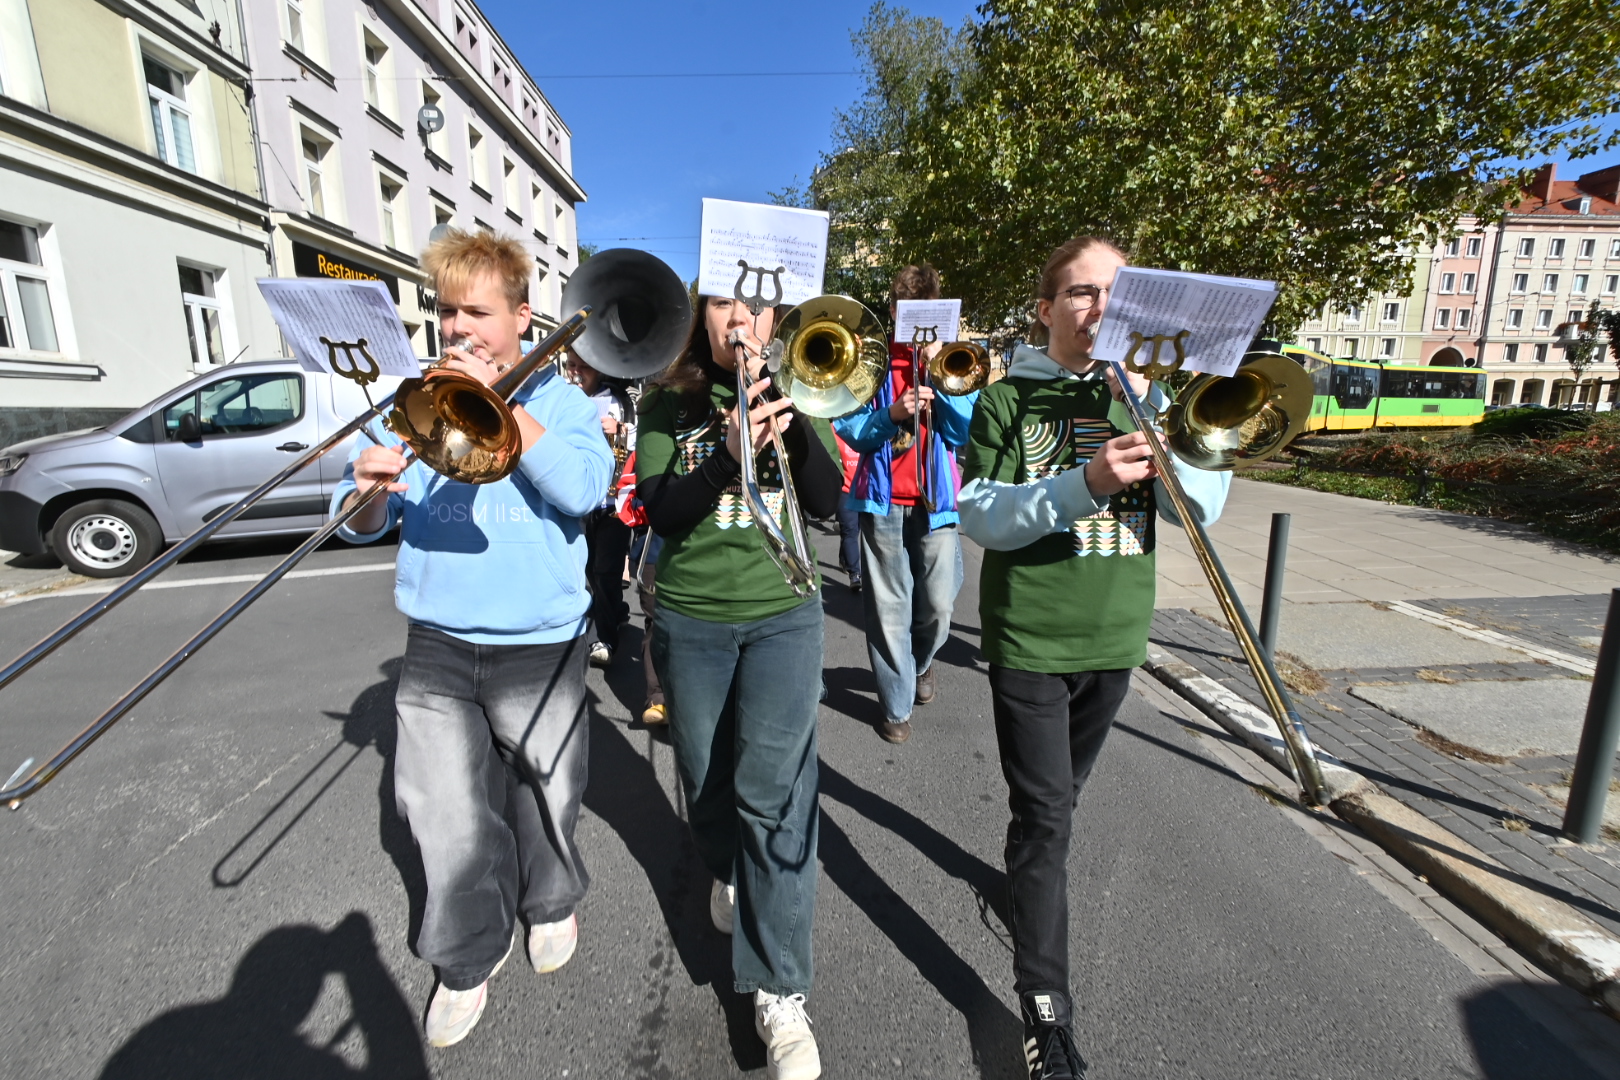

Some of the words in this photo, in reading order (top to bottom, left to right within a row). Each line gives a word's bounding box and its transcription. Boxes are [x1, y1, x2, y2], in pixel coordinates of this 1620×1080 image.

[317, 254, 382, 281] Restaura
[427, 502, 488, 523] POSM
[509, 504, 533, 522] st.
